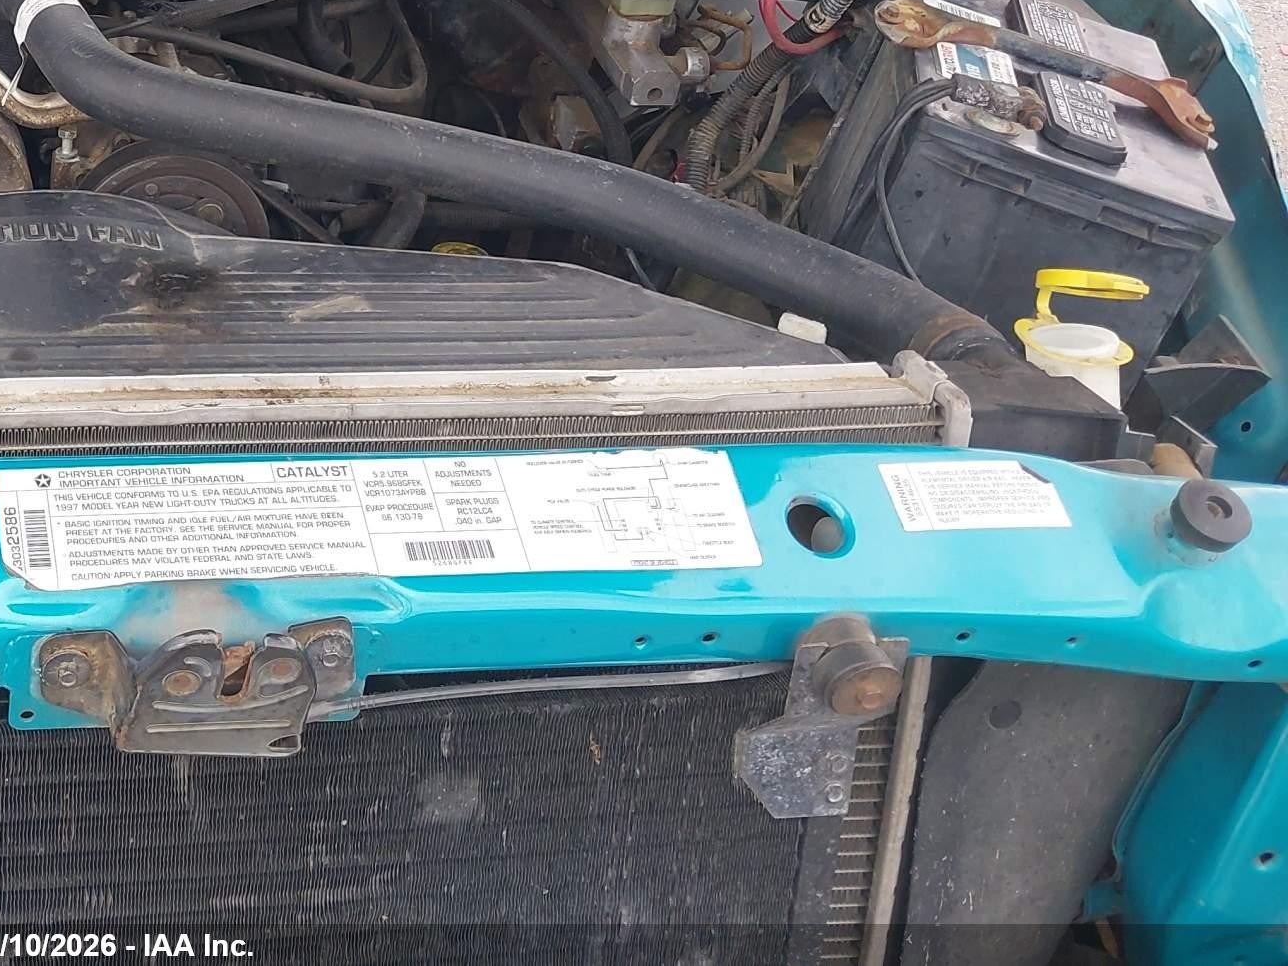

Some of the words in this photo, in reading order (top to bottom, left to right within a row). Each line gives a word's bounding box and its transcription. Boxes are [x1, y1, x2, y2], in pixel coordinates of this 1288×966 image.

[88, 222, 163, 250] FAN
[57, 469, 113, 478] CHRYSLER
[116, 467, 190, 476] CORPORATION
[276, 465, 349, 478] CATALYST
[434, 469, 491, 477] ADJUSTMENTS
[58, 478, 120, 487] IMPORTANT
[125, 477, 167, 485] VEHICLE
[170, 474, 244, 483] INFORMATION
[53, 493, 73, 501] THIS
[75, 492, 112, 500] VEHICLE
[114, 490, 165, 499] CONFORMS
[221, 486, 283, 495] REGULATIONS
[285, 485, 337, 493] APPLICABLE
[890, 474, 917, 523] WARNING
[55, 503, 78, 511] 1997
[81, 502, 112, 510] MODEL
[116, 501, 139, 509] YEAR
[141, 500, 164, 508] NEW
[166, 499, 217, 507] LIGHT-DUTY
[220, 497, 255, 505] TRUCKS
[253, 513, 292, 521] MIXTURE
[66, 536, 125, 545] PROCEDURES
[182, 533, 232, 541] ADDITIONAL
[68, 549, 134, 558] ADJUSTMENTS
[180, 546, 210, 554] OTHER
[212, 545, 237, 553] THAN
[239, 544, 286, 552] APPROVED
[288, 542, 324, 550] SERVICE
[69, 559, 129, 567] PROCEDURES
[113, 571, 141, 579] APPLY
[144, 569, 184, 578] PARKING
[186, 568, 216, 576] BRAKE
[219, 567, 248, 575] WHEN
[250, 565, 297, 573] SERVICING
